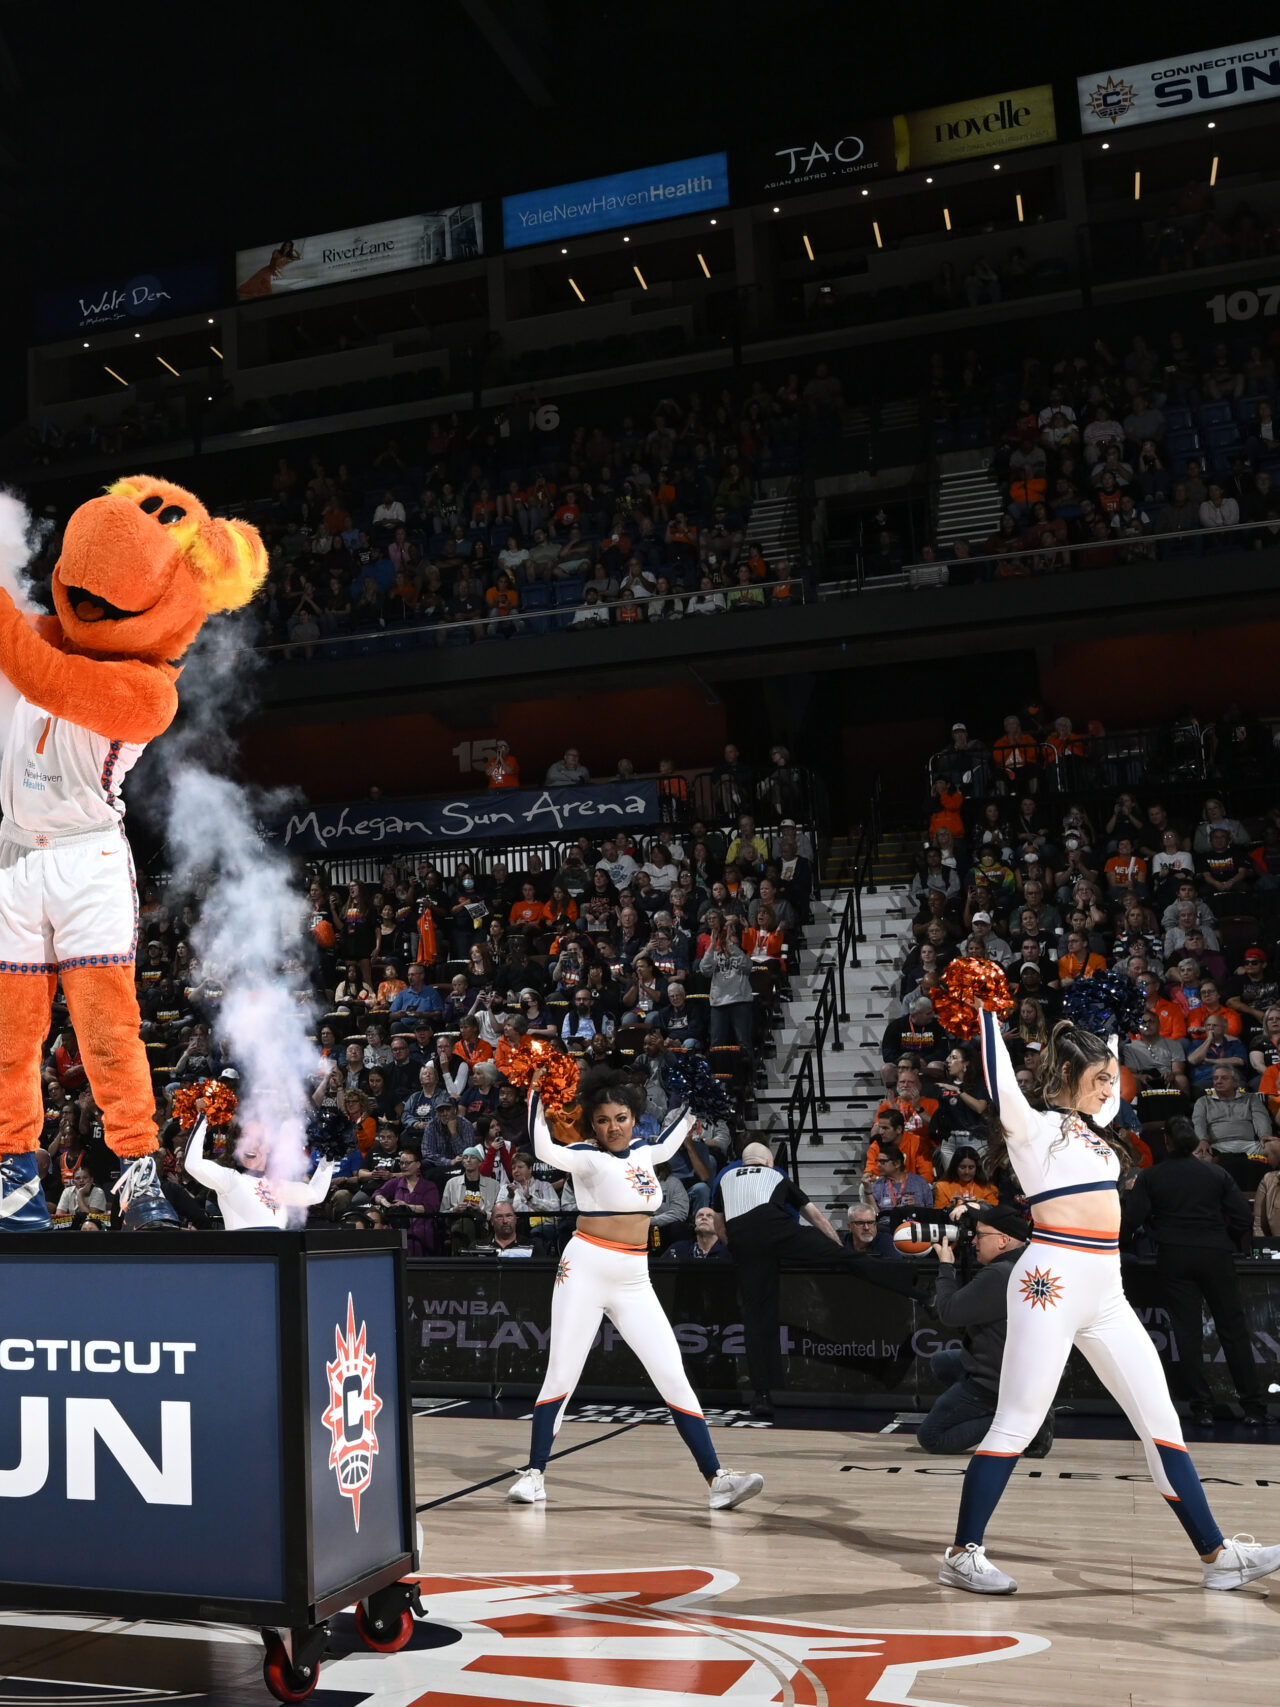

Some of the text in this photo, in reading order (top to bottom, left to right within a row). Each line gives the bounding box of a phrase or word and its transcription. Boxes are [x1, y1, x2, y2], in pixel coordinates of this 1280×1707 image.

[1151, 47, 1279, 81] CONNECTICUT
[1155, 60, 1280, 108] SUN
[935, 100, 1031, 143] novelle
[774, 136, 865, 175] TAO
[763, 161, 880, 190] ASIAN BISTRO LOUNGE
[518, 175, 713, 228] YaleNewHavenHealth
[322, 239, 395, 264] RiverLane
[79, 286, 172, 317] Wolf Den
[1206, 284, 1280, 324] 107
[452, 739, 497, 773] 15
[22, 779, 46, 791] Health
[24, 768, 62, 782] NewHaven
[284, 791, 646, 848] Mohegan Sun Arena
[423, 1299, 510, 1316] WNBA
[802, 1338, 876, 1357] Presented
[882, 1339, 900, 1360] by
